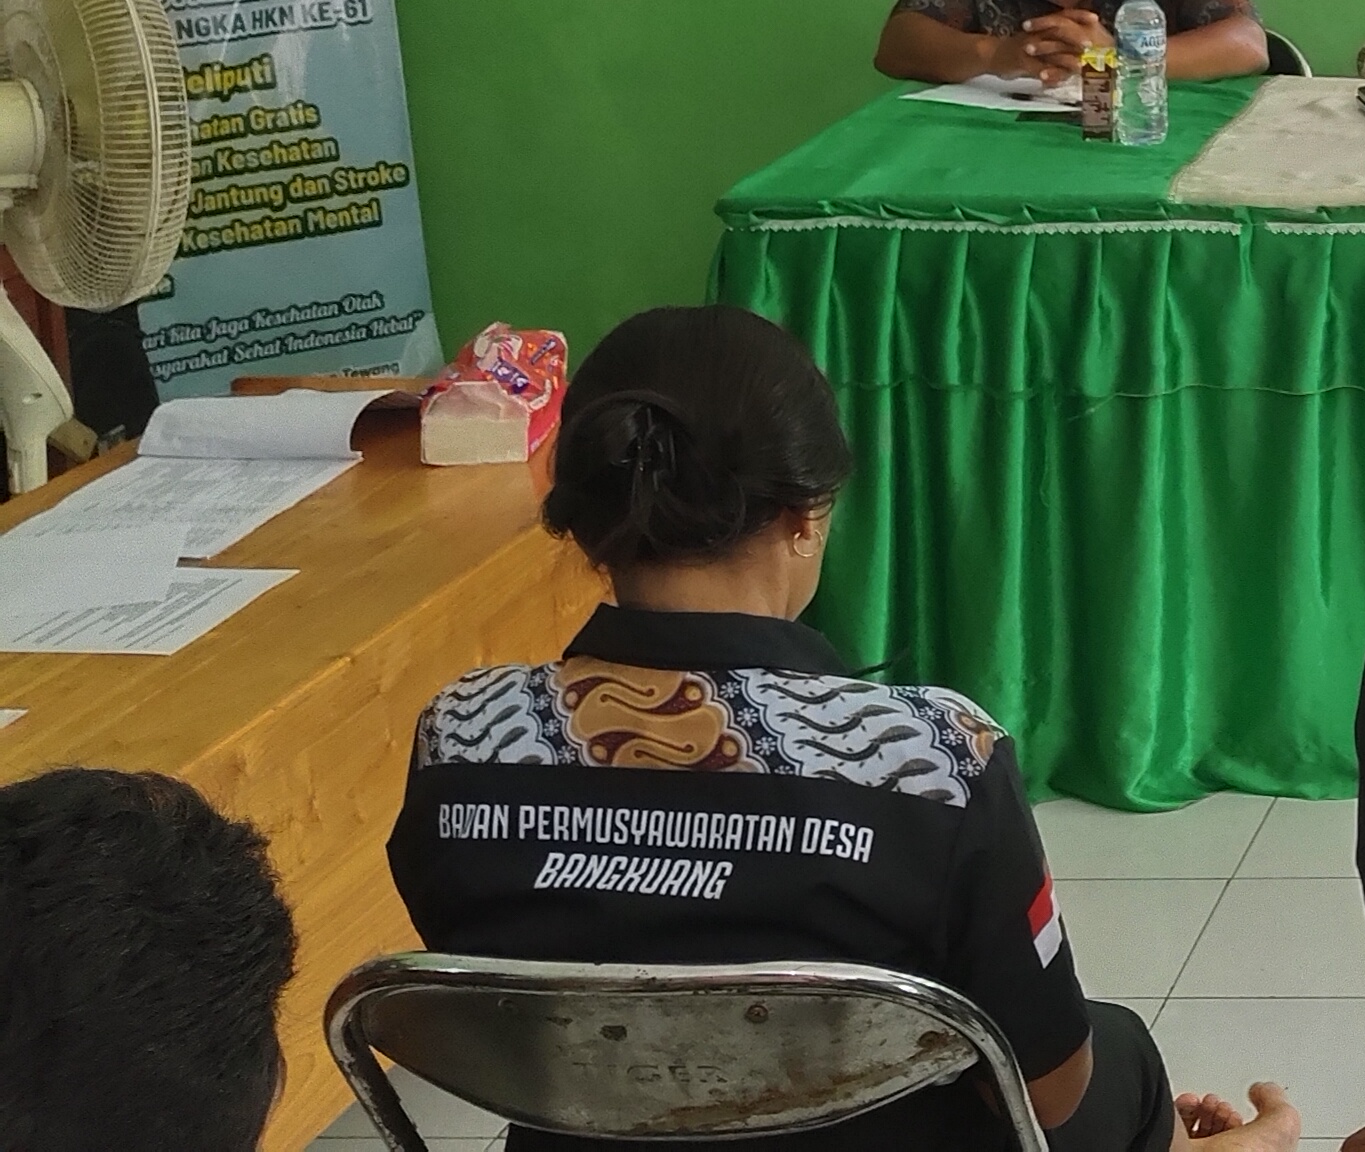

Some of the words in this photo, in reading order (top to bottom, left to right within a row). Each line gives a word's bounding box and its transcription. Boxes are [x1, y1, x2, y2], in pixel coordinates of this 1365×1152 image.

[251, 6, 295, 31] HKN
[186, 56, 273, 96] eliputi
[250, 103, 318, 132] Gratis
[217, 139, 338, 173] Kesehatan
[191, 182, 283, 215] Jantung
[290, 175, 331, 200] dan
[334, 164, 407, 190] Stroke
[182, 215, 301, 253] Kesehatan
[305, 200, 380, 232] Mental
[205, 317, 250, 342] Jaga
[252, 301, 339, 329] Kesehatan
[152, 349, 229, 382] syarakat
[234, 339, 282, 364] Sehat
[285, 327, 368, 352] Indonesia
[439, 804, 509, 840] BADAN
[518, 805, 797, 854] PERMUSYAWARATAN
[801, 817, 875, 864] DESA
[534, 853, 733, 900] BANGKUANG
